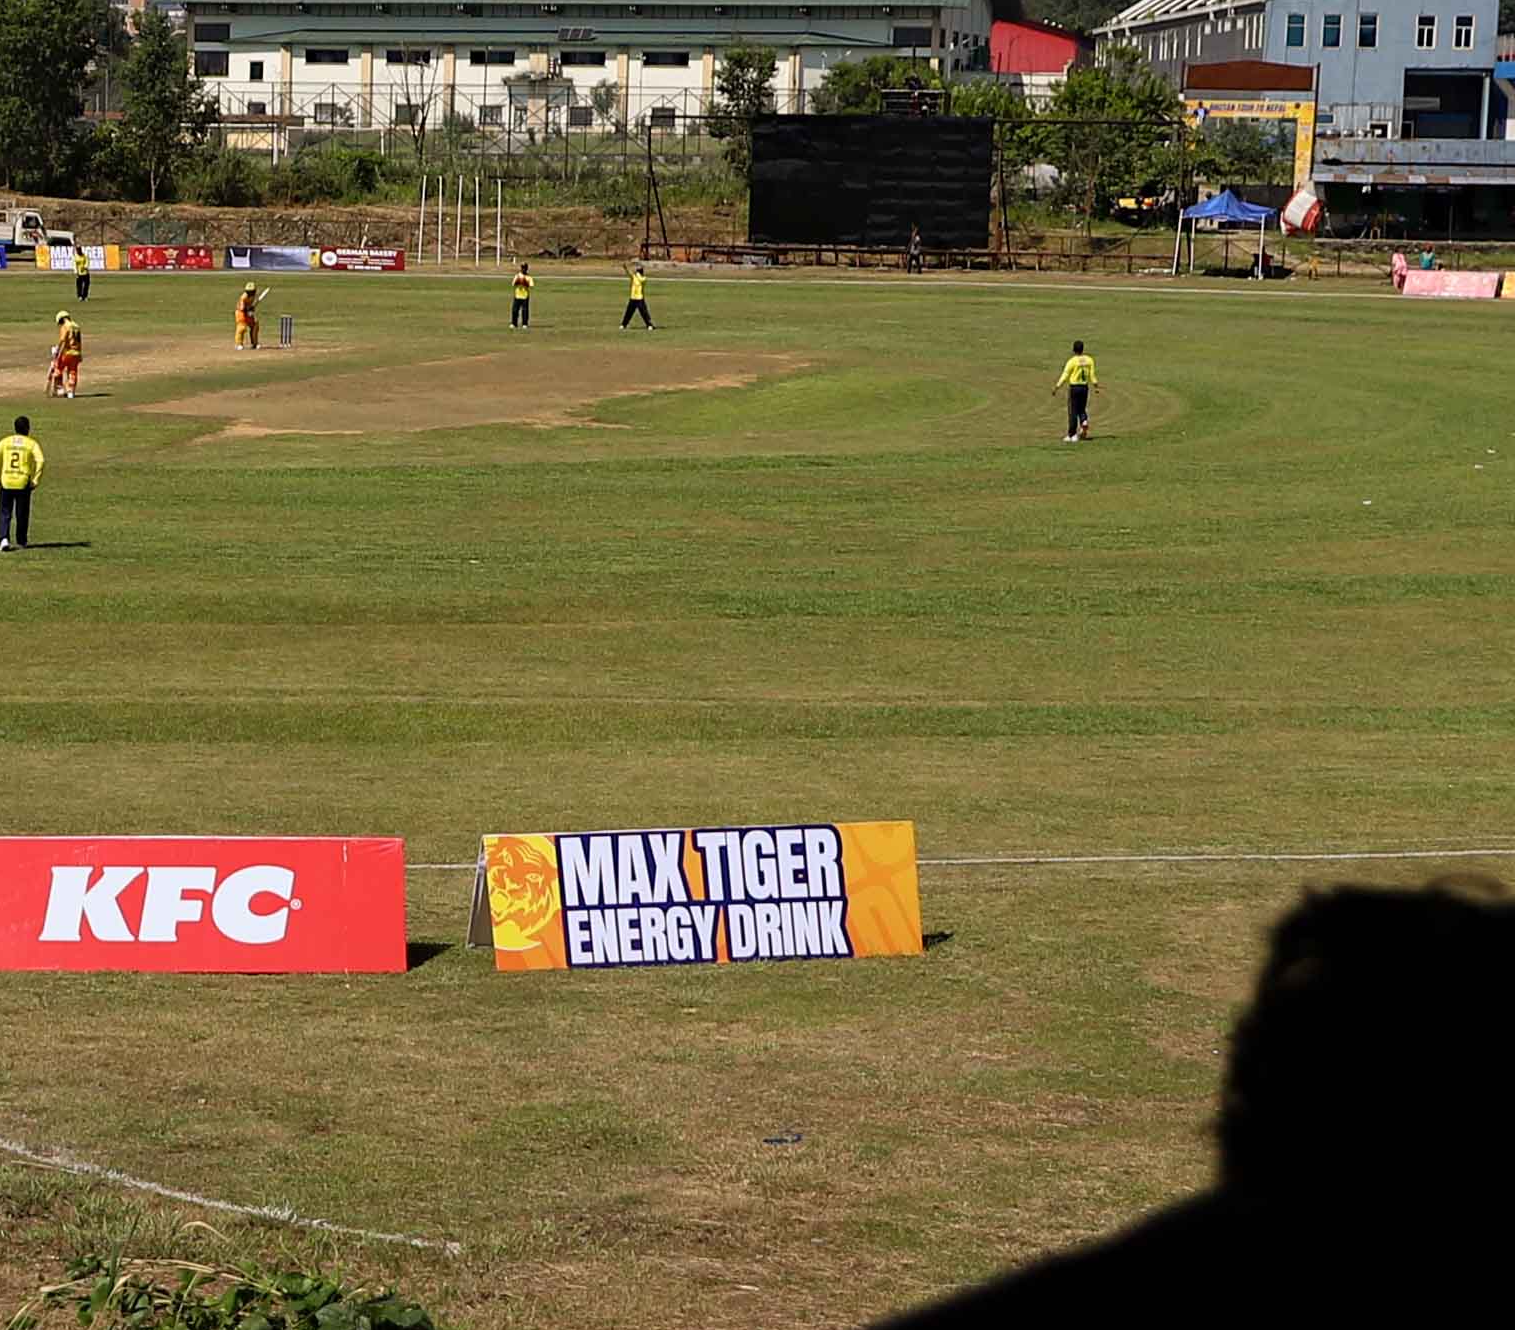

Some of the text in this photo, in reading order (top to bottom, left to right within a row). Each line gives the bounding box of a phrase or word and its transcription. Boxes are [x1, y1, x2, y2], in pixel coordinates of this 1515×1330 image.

[11, 452, 19, 468] 2
[38, 865, 294, 945] KFC
[560, 828, 842, 908] MAX TIGER
[567, 898, 848, 966] ENERGY DRINK
